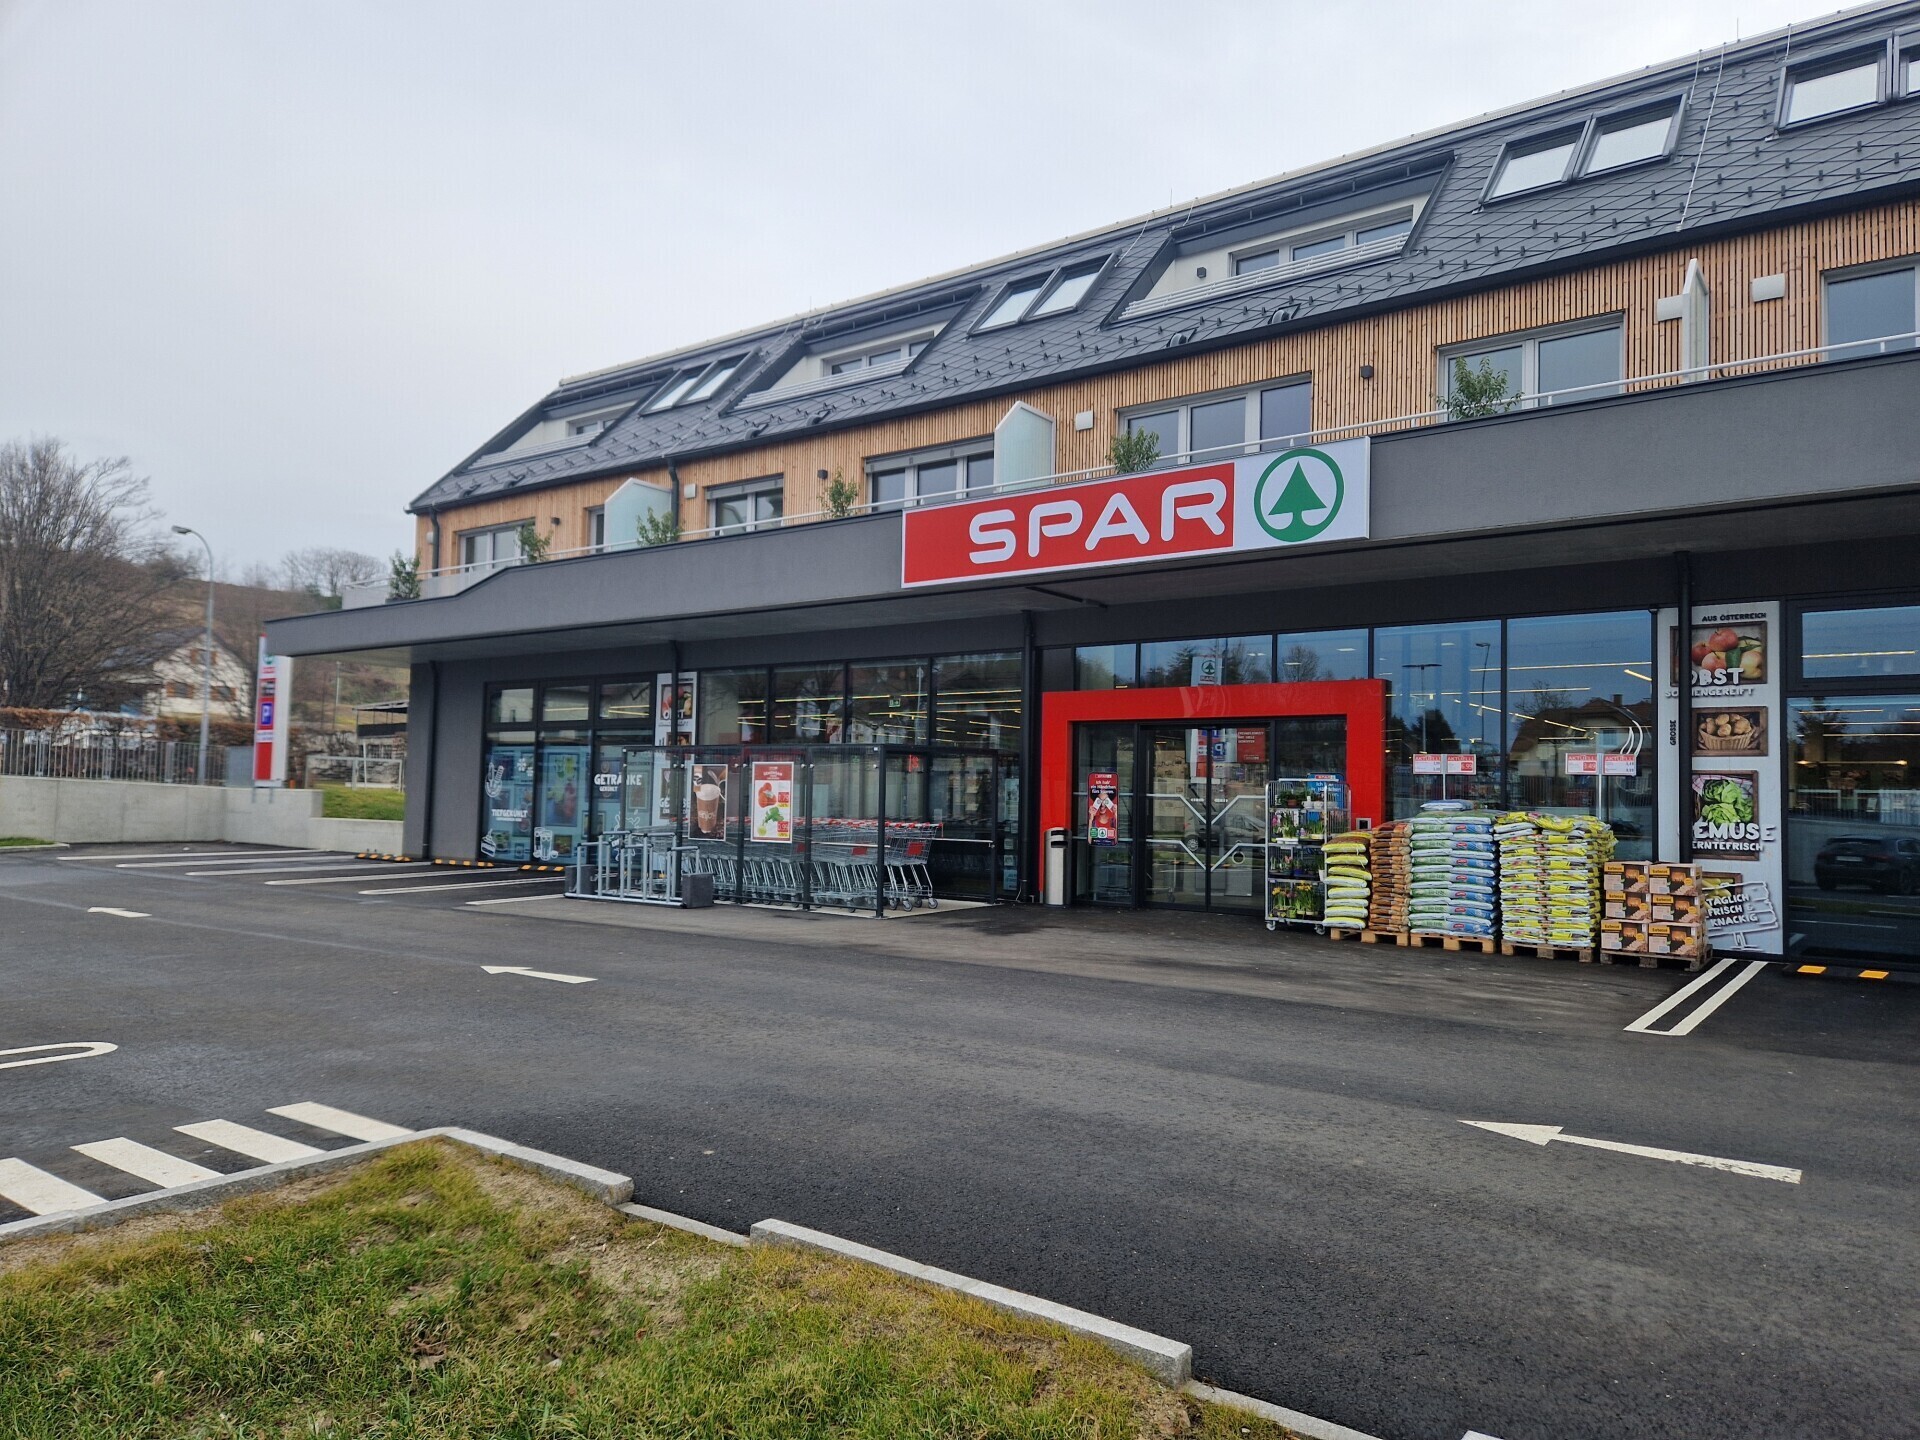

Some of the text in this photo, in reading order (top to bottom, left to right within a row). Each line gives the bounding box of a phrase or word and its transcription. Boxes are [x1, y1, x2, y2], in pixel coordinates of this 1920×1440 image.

[969, 478, 1228, 564] SPAR
[1692, 821, 1776, 841] EMÜSE
[1708, 905, 1743, 917] FRISCH
[1711, 914, 1758, 927] KNACKIG
